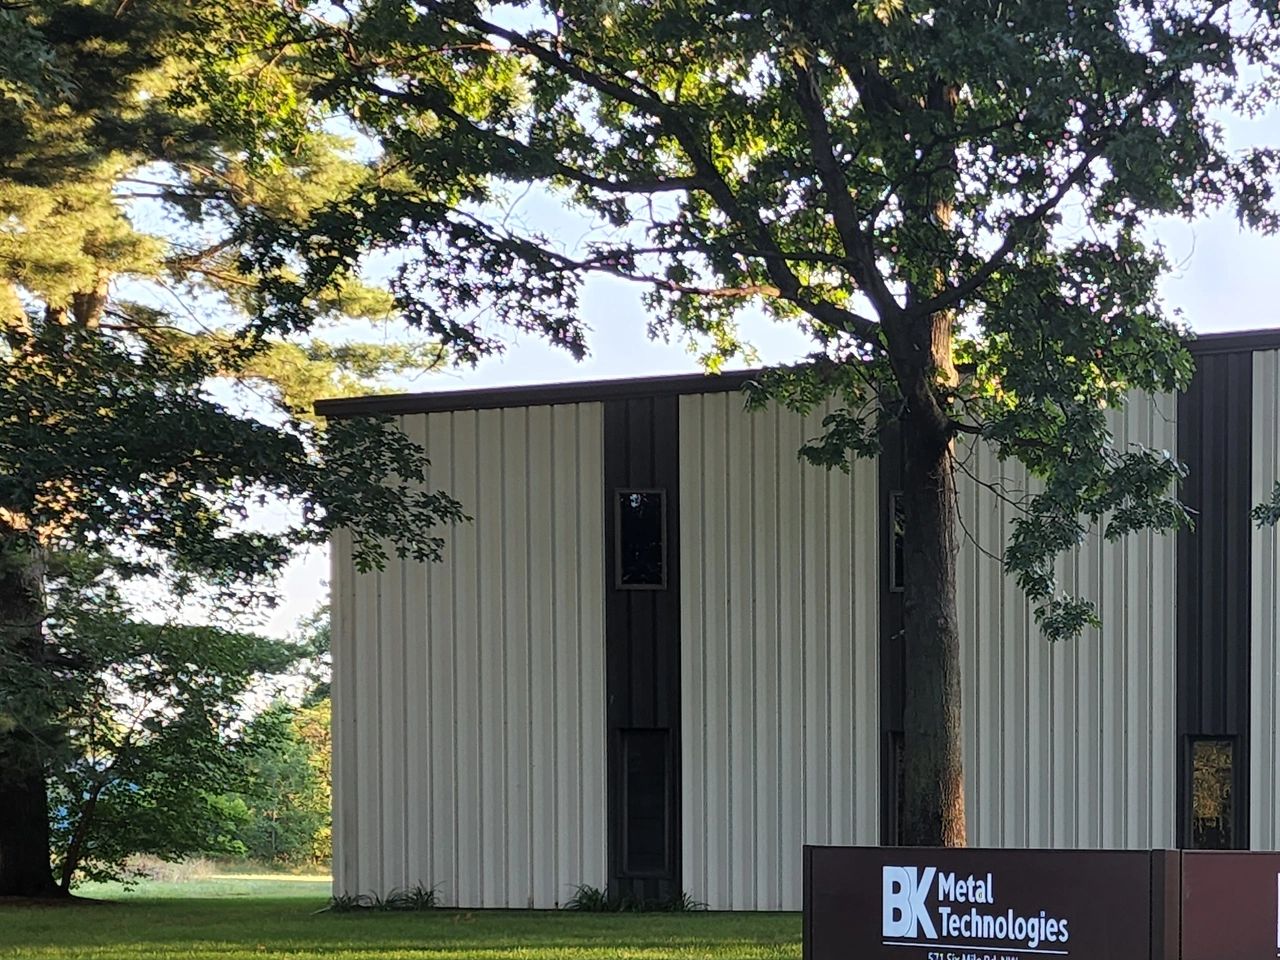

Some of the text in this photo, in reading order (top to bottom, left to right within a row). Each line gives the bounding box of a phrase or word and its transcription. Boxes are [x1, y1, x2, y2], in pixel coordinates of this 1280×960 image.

[882, 866, 938, 939] BK
[938, 872, 994, 903] Metal
[938, 906, 1069, 948] Technologies
